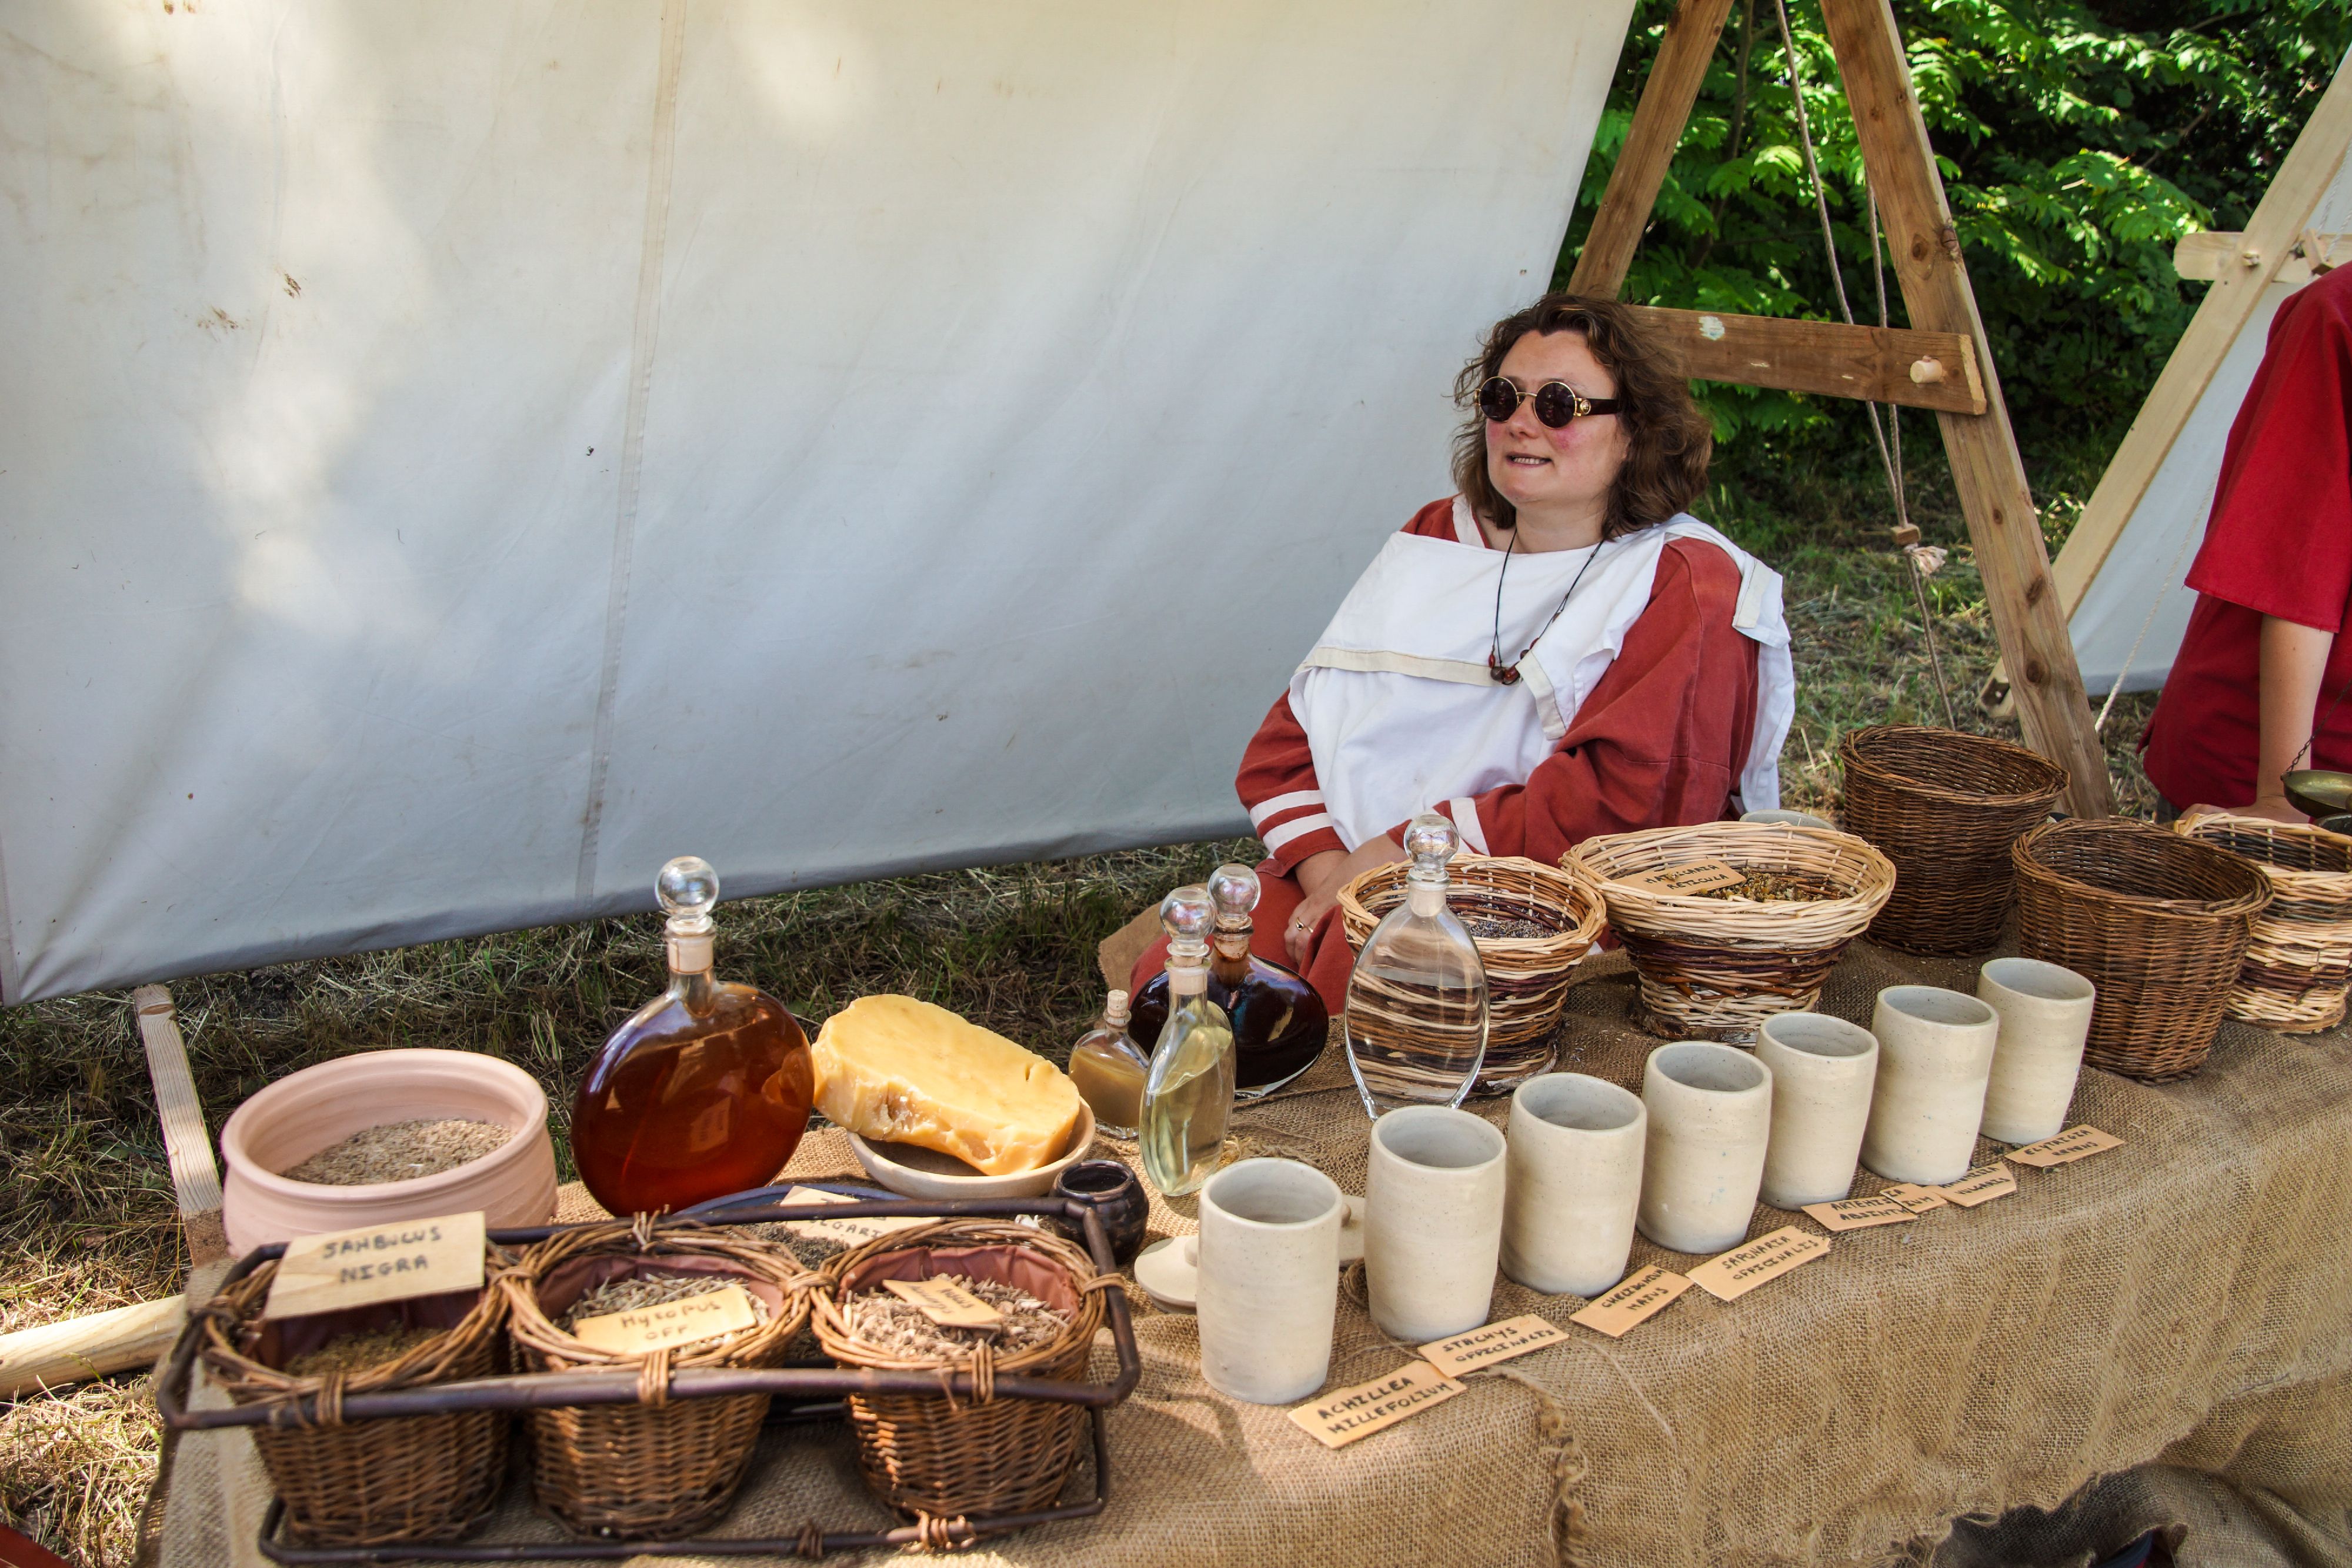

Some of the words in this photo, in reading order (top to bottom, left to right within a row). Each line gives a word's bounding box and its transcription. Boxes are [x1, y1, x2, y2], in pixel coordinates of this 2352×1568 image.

[1643, 865, 1720, 883] MATICARIA
[1667, 874, 1729, 889] RETICULA
[1954, 1177, 2011, 1195] VULGARIS
[322, 1226, 442, 1259] SAMBUCUS
[1722, 1235, 1791, 1269] SAPONARIA
[341, 1255, 428, 1284] NIGRA
[1733, 1239, 1819, 1280] OFFICINALIS
[1442, 1326, 1518, 1352] STACHYS
[1317, 1377, 1414, 1419] ACHILLEA
[1326, 1381, 1454, 1434] MILLEFOLIUM
